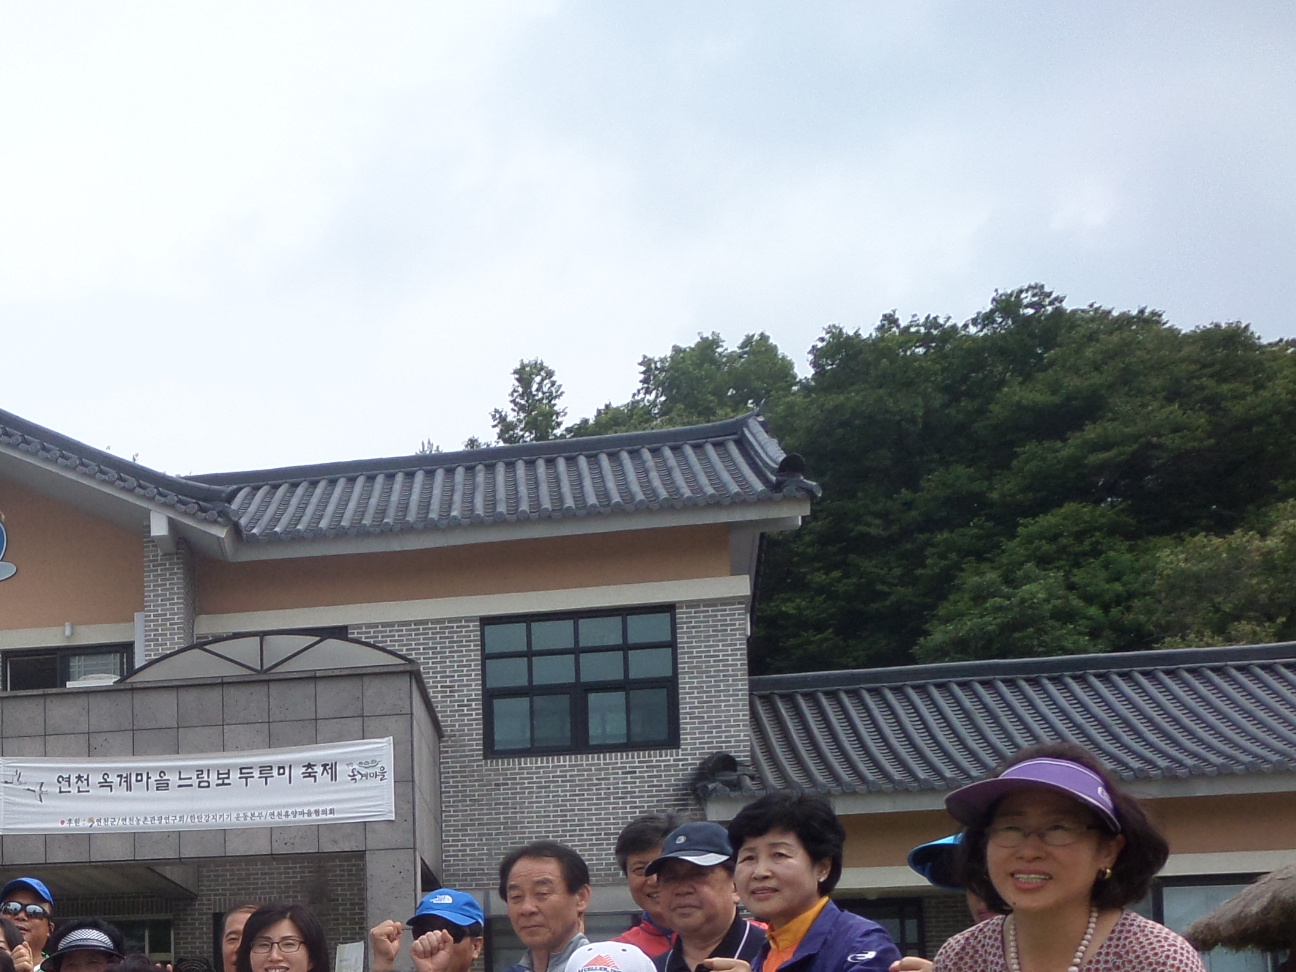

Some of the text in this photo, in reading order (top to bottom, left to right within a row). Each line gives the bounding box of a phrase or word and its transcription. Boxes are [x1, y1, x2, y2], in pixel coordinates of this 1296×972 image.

[56, 760, 338, 794] 연천 옥계마을 느림보 두루미 축제
[346, 765, 388, 784] 옥계마을
